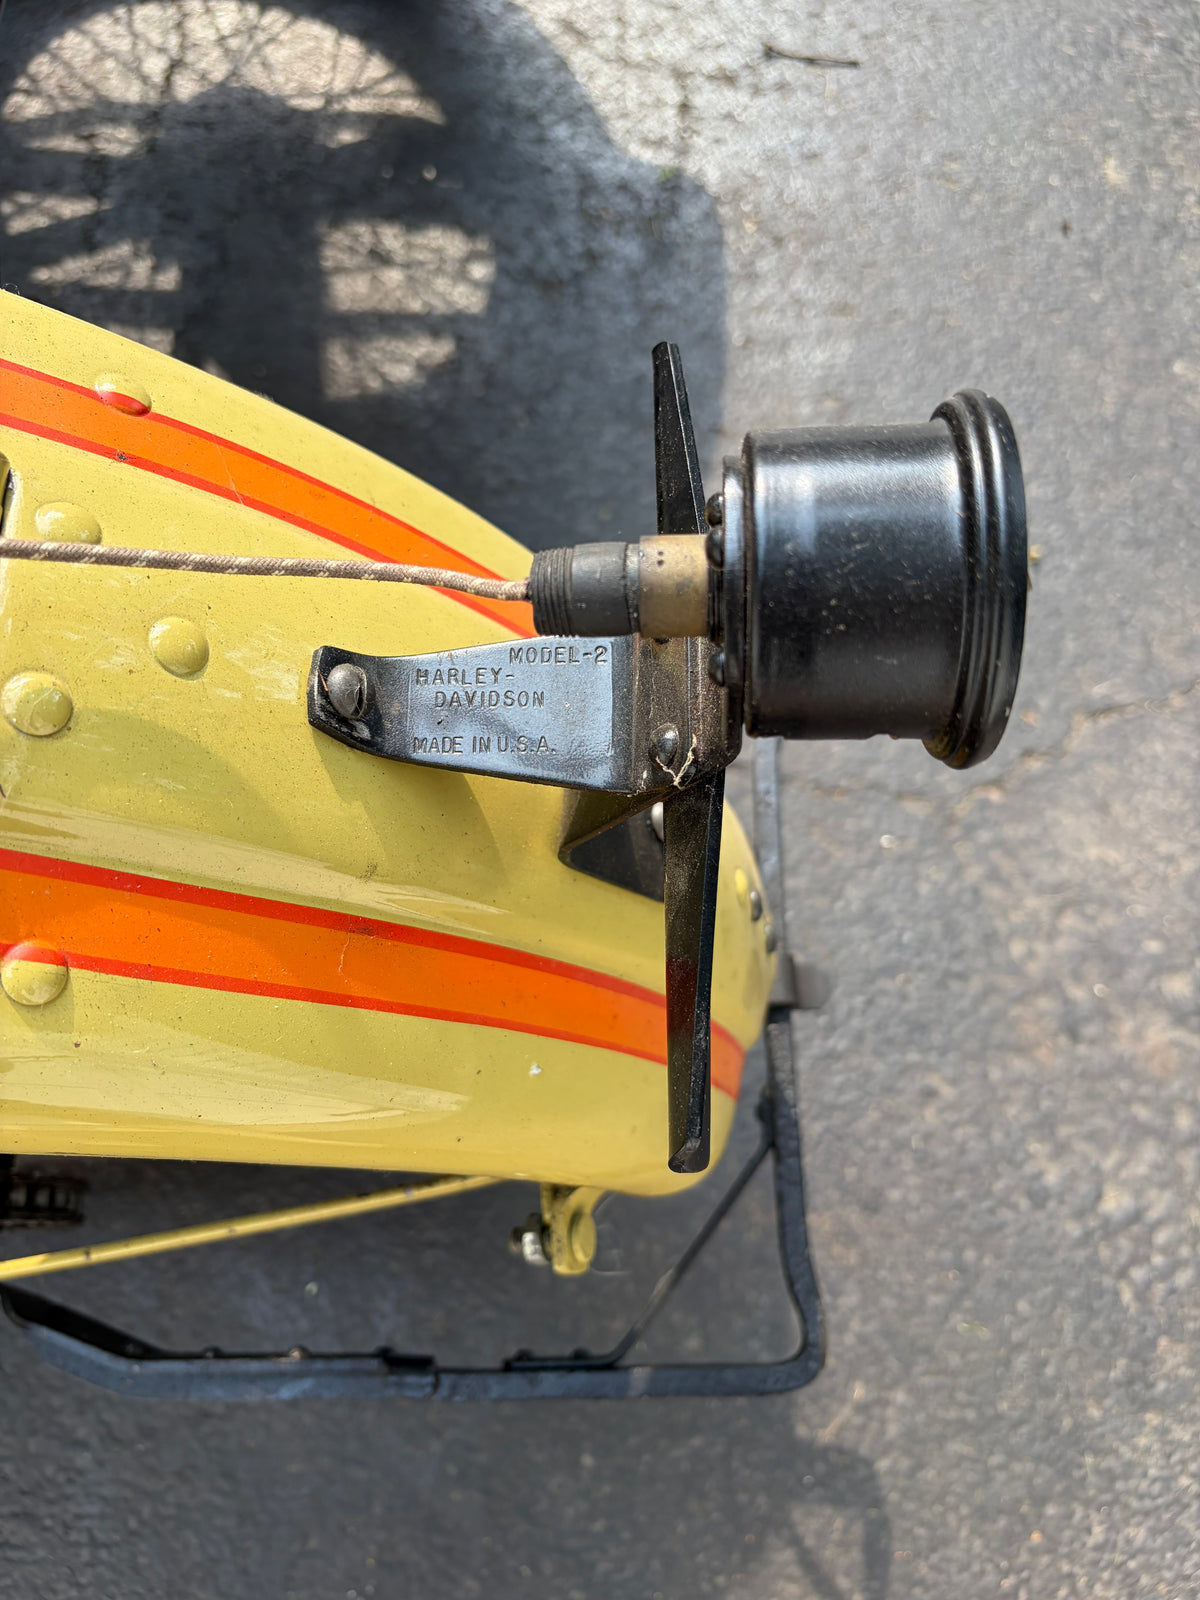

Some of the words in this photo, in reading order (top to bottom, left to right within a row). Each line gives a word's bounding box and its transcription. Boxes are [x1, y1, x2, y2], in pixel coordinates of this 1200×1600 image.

[509, 645, 608, 665] MODEL-2
[415, 667, 515, 686] HARLEY-
[434, 690, 545, 709] DAVIDSON
[412, 736, 463, 755] MADE
[472, 736, 491, 754] IN
[497, 735, 556, 754] U.S.A.
